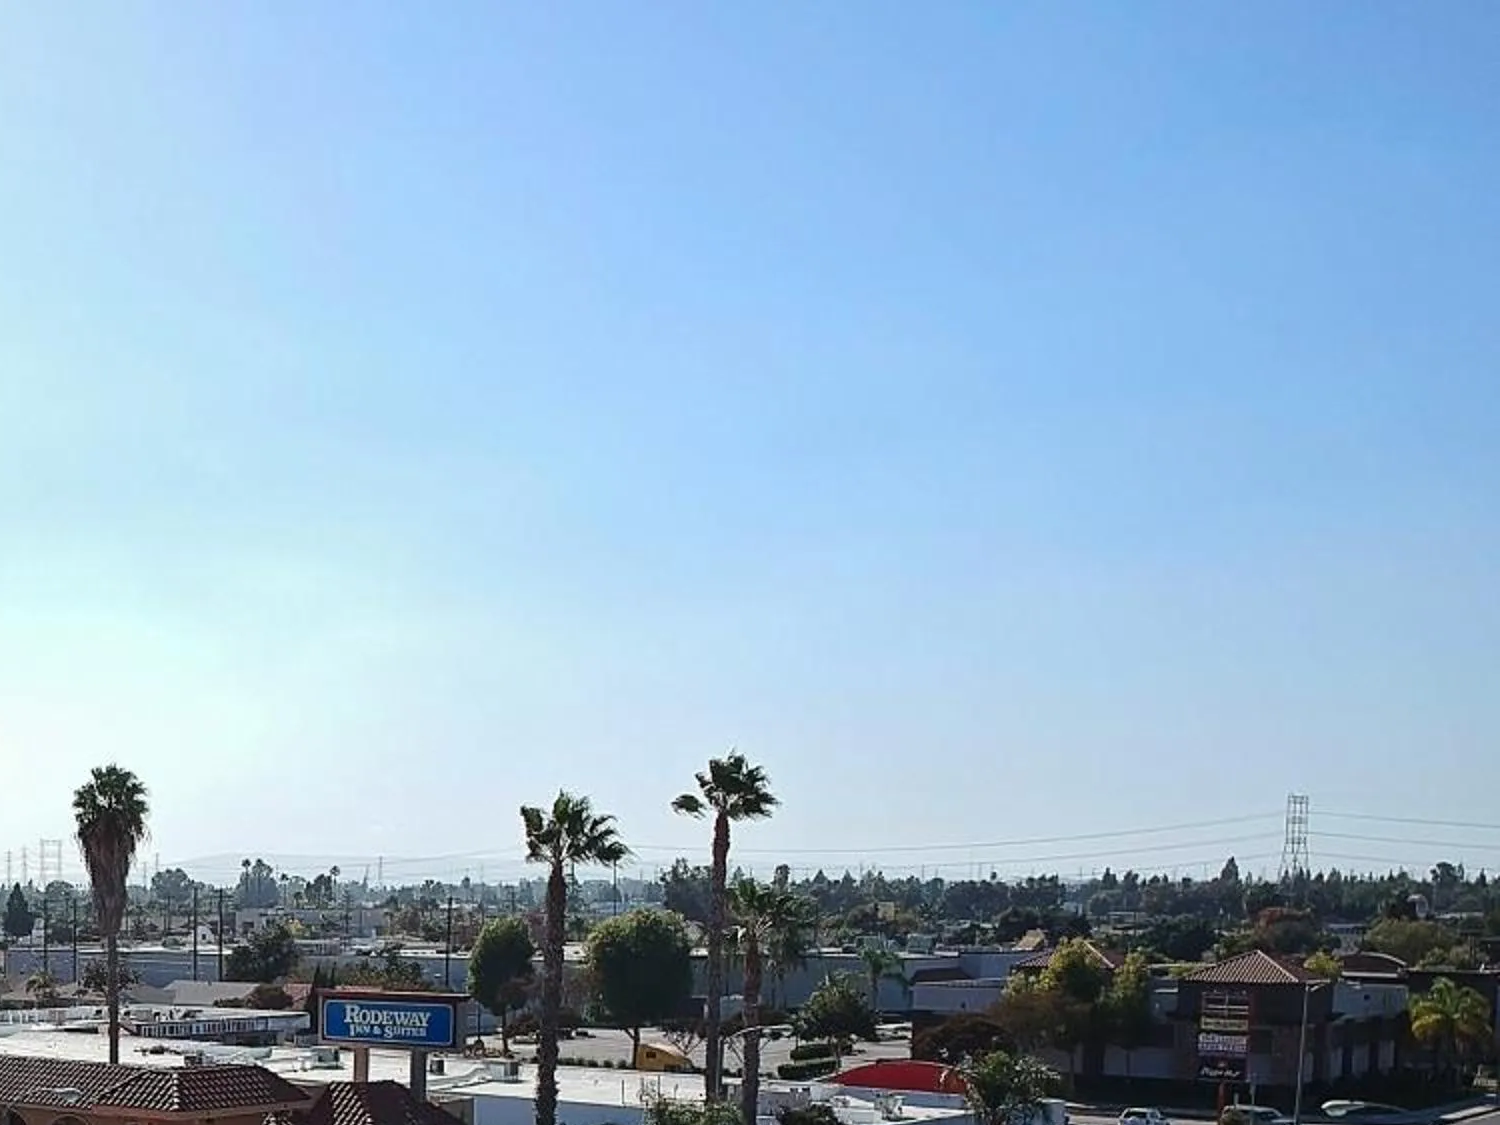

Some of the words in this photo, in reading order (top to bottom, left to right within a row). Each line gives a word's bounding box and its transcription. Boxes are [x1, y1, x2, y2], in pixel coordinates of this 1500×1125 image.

[344, 1004, 432, 1027] RODEWAY
[350, 1025, 371, 1037] INN
[373, 1026, 382, 1035] &
[384, 1026, 427, 1039] SUITES
